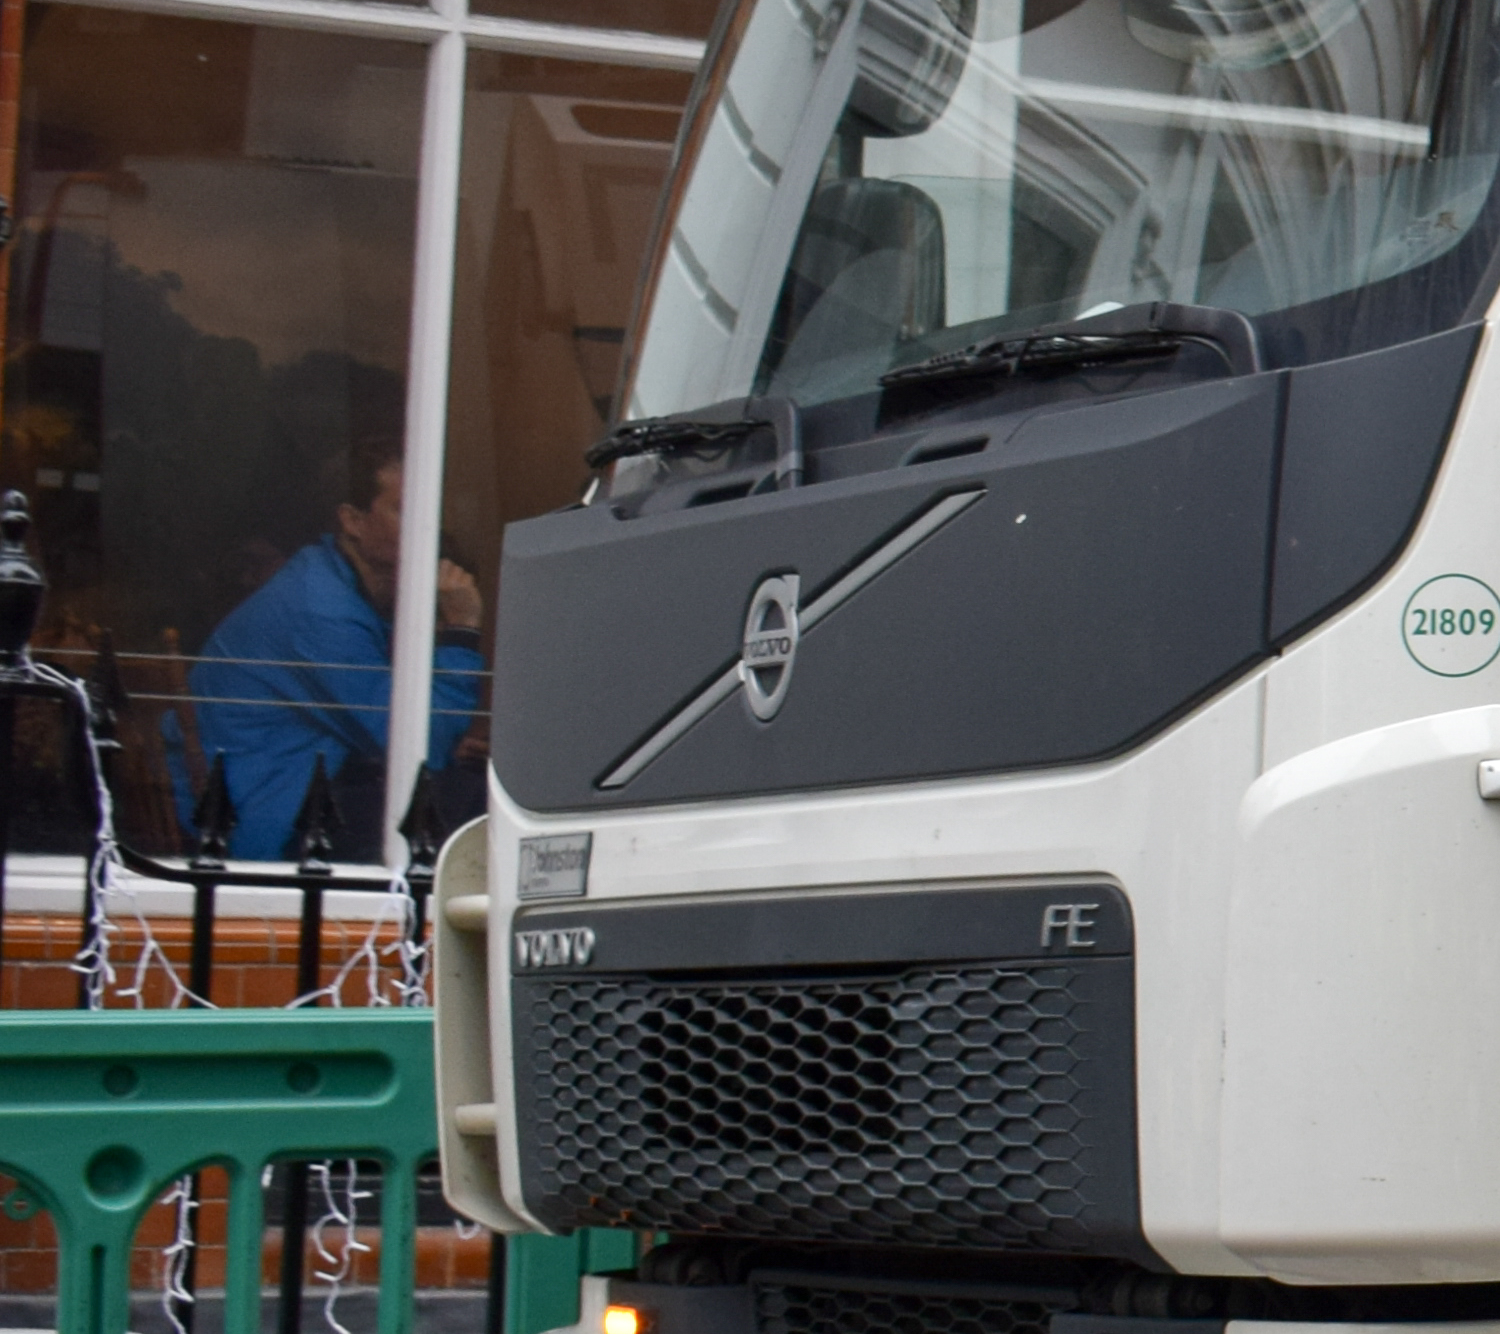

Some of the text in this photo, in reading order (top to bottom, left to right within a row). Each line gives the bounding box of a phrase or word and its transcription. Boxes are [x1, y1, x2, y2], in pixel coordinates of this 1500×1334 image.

[1411, 608, 1496, 636] 21809
[1041, 903, 1100, 947] FE
[514, 927, 596, 967] VOLVO
